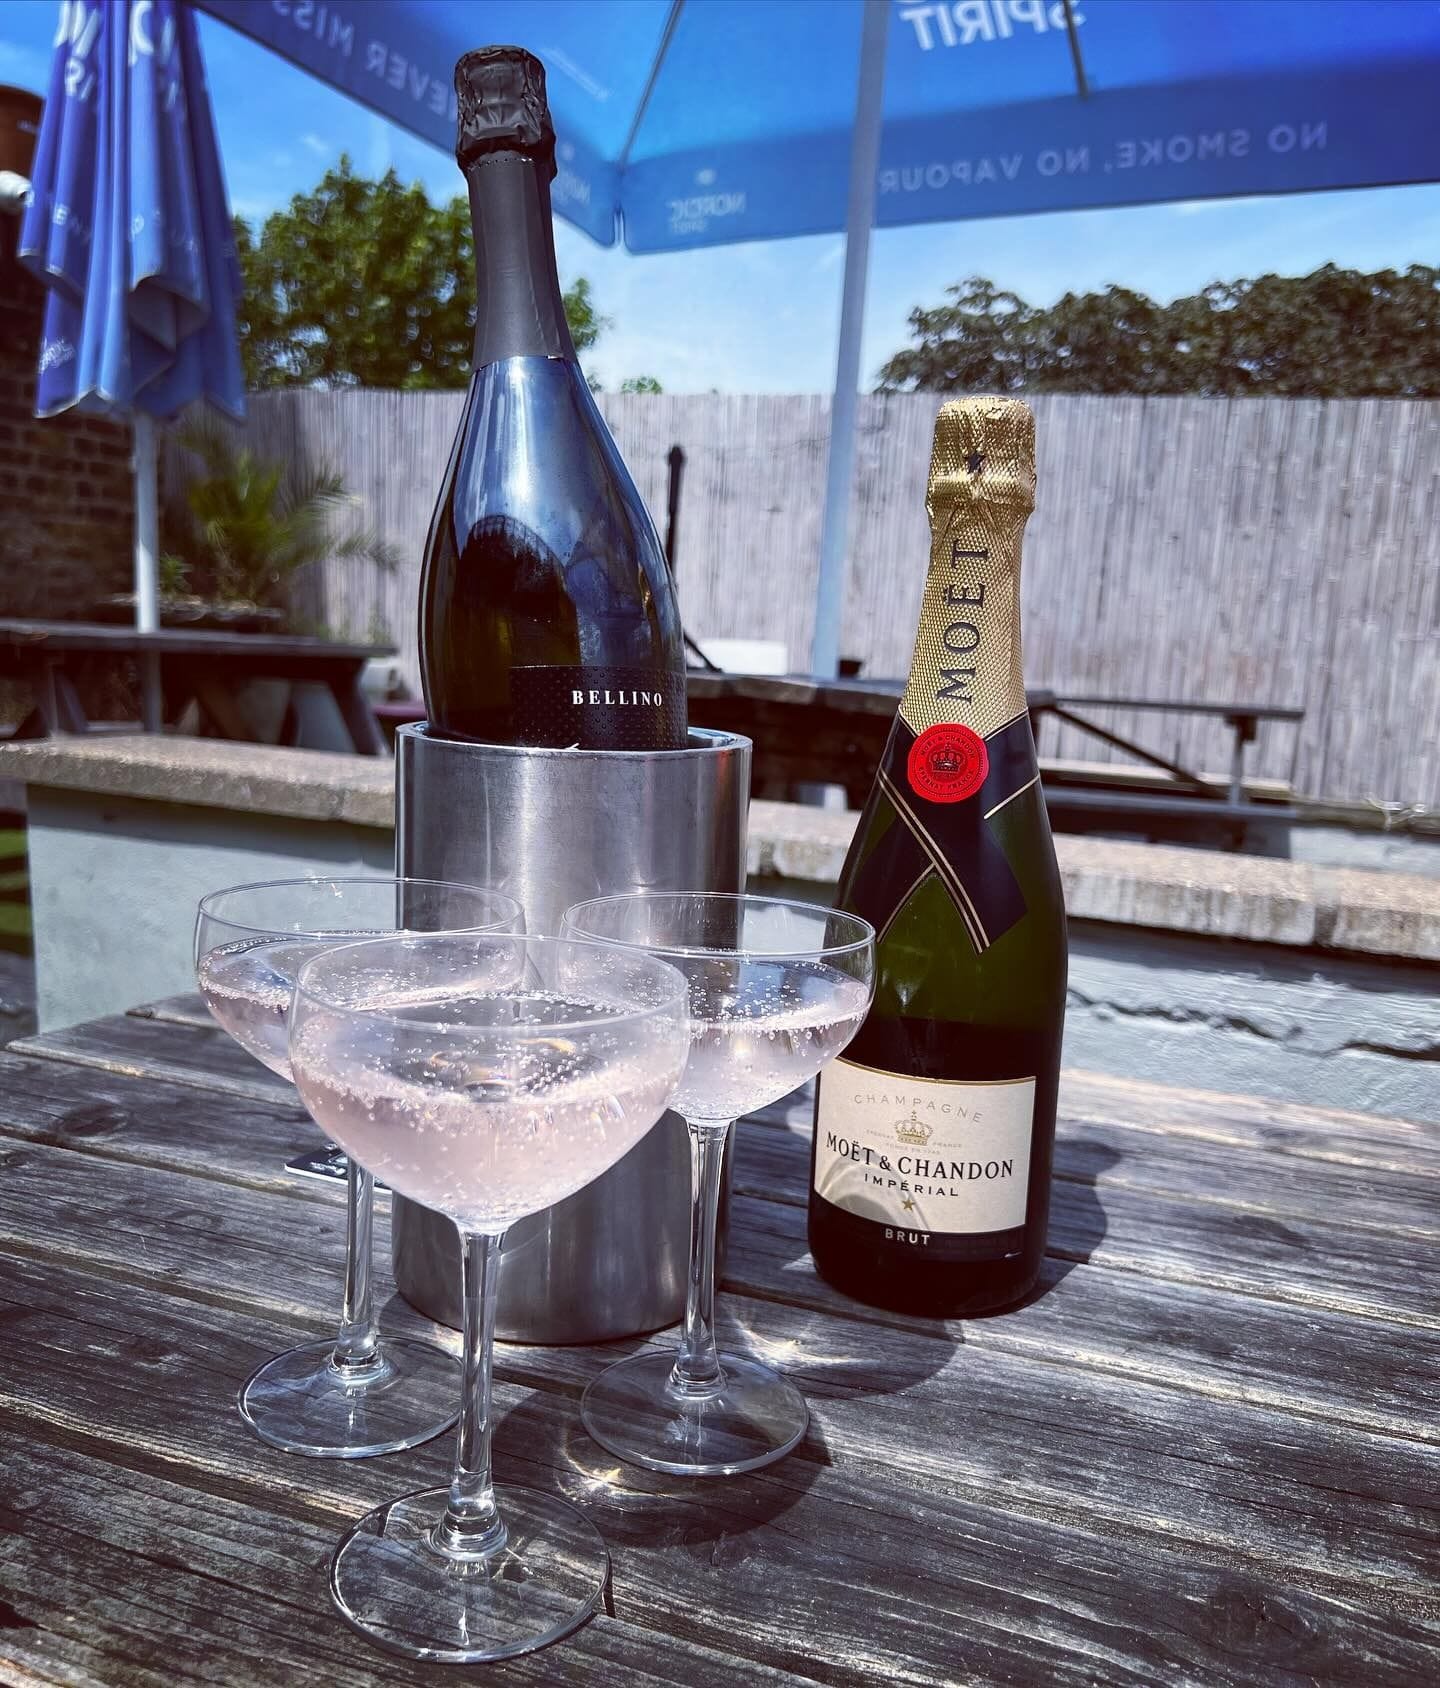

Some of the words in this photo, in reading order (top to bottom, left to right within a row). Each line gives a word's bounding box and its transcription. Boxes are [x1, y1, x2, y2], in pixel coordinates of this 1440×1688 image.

[572, 690, 663, 707] BELLINO
[854, 1094, 983, 1123] CHAMPAGNE
[827, 1132, 875, 1166] MOËT
[879, 1155, 892, 1171] &
[898, 1156, 1014, 1180] CHANDON
[864, 1173, 959, 1197] IMPÉRIAL
[885, 1228, 930, 1245] BRUT
